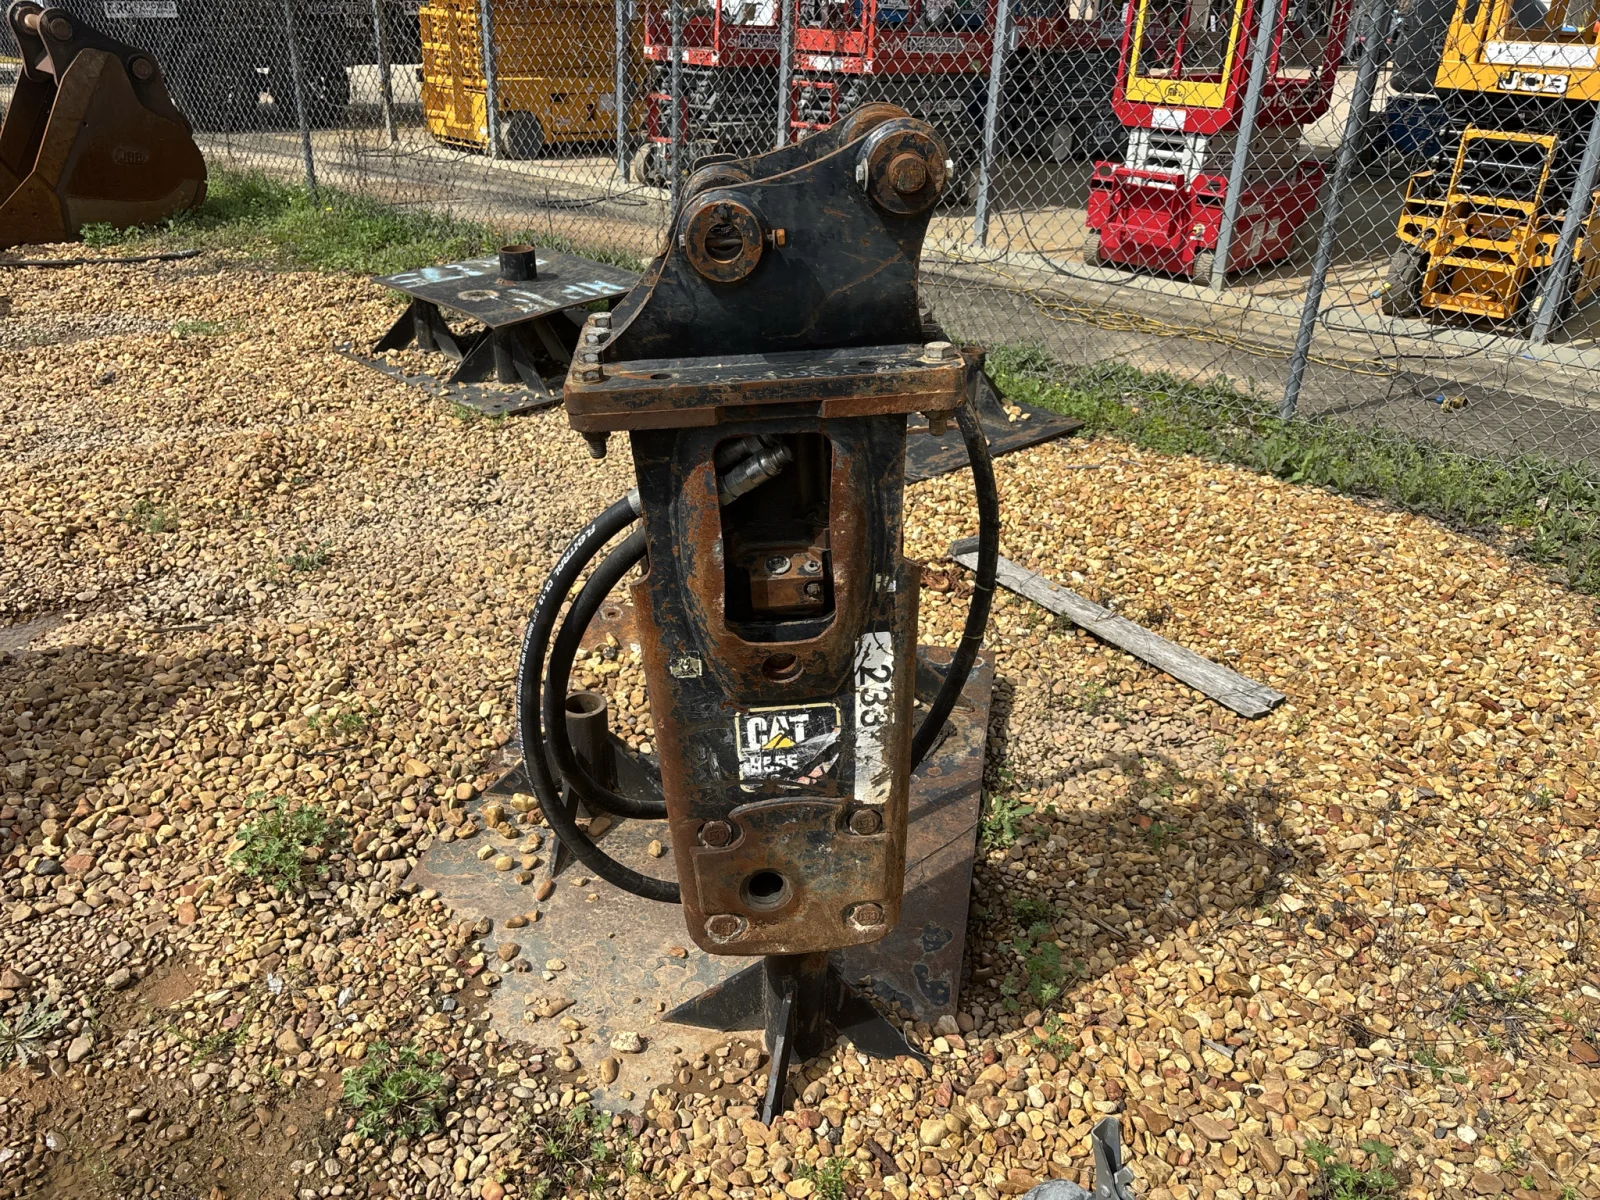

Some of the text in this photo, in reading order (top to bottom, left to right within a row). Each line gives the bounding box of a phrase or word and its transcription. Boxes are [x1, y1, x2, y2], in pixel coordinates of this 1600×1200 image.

[1499, 70, 1570, 94] JCB
[537, 578, 554, 606] CX-12
[746, 714, 809, 749] CAT
